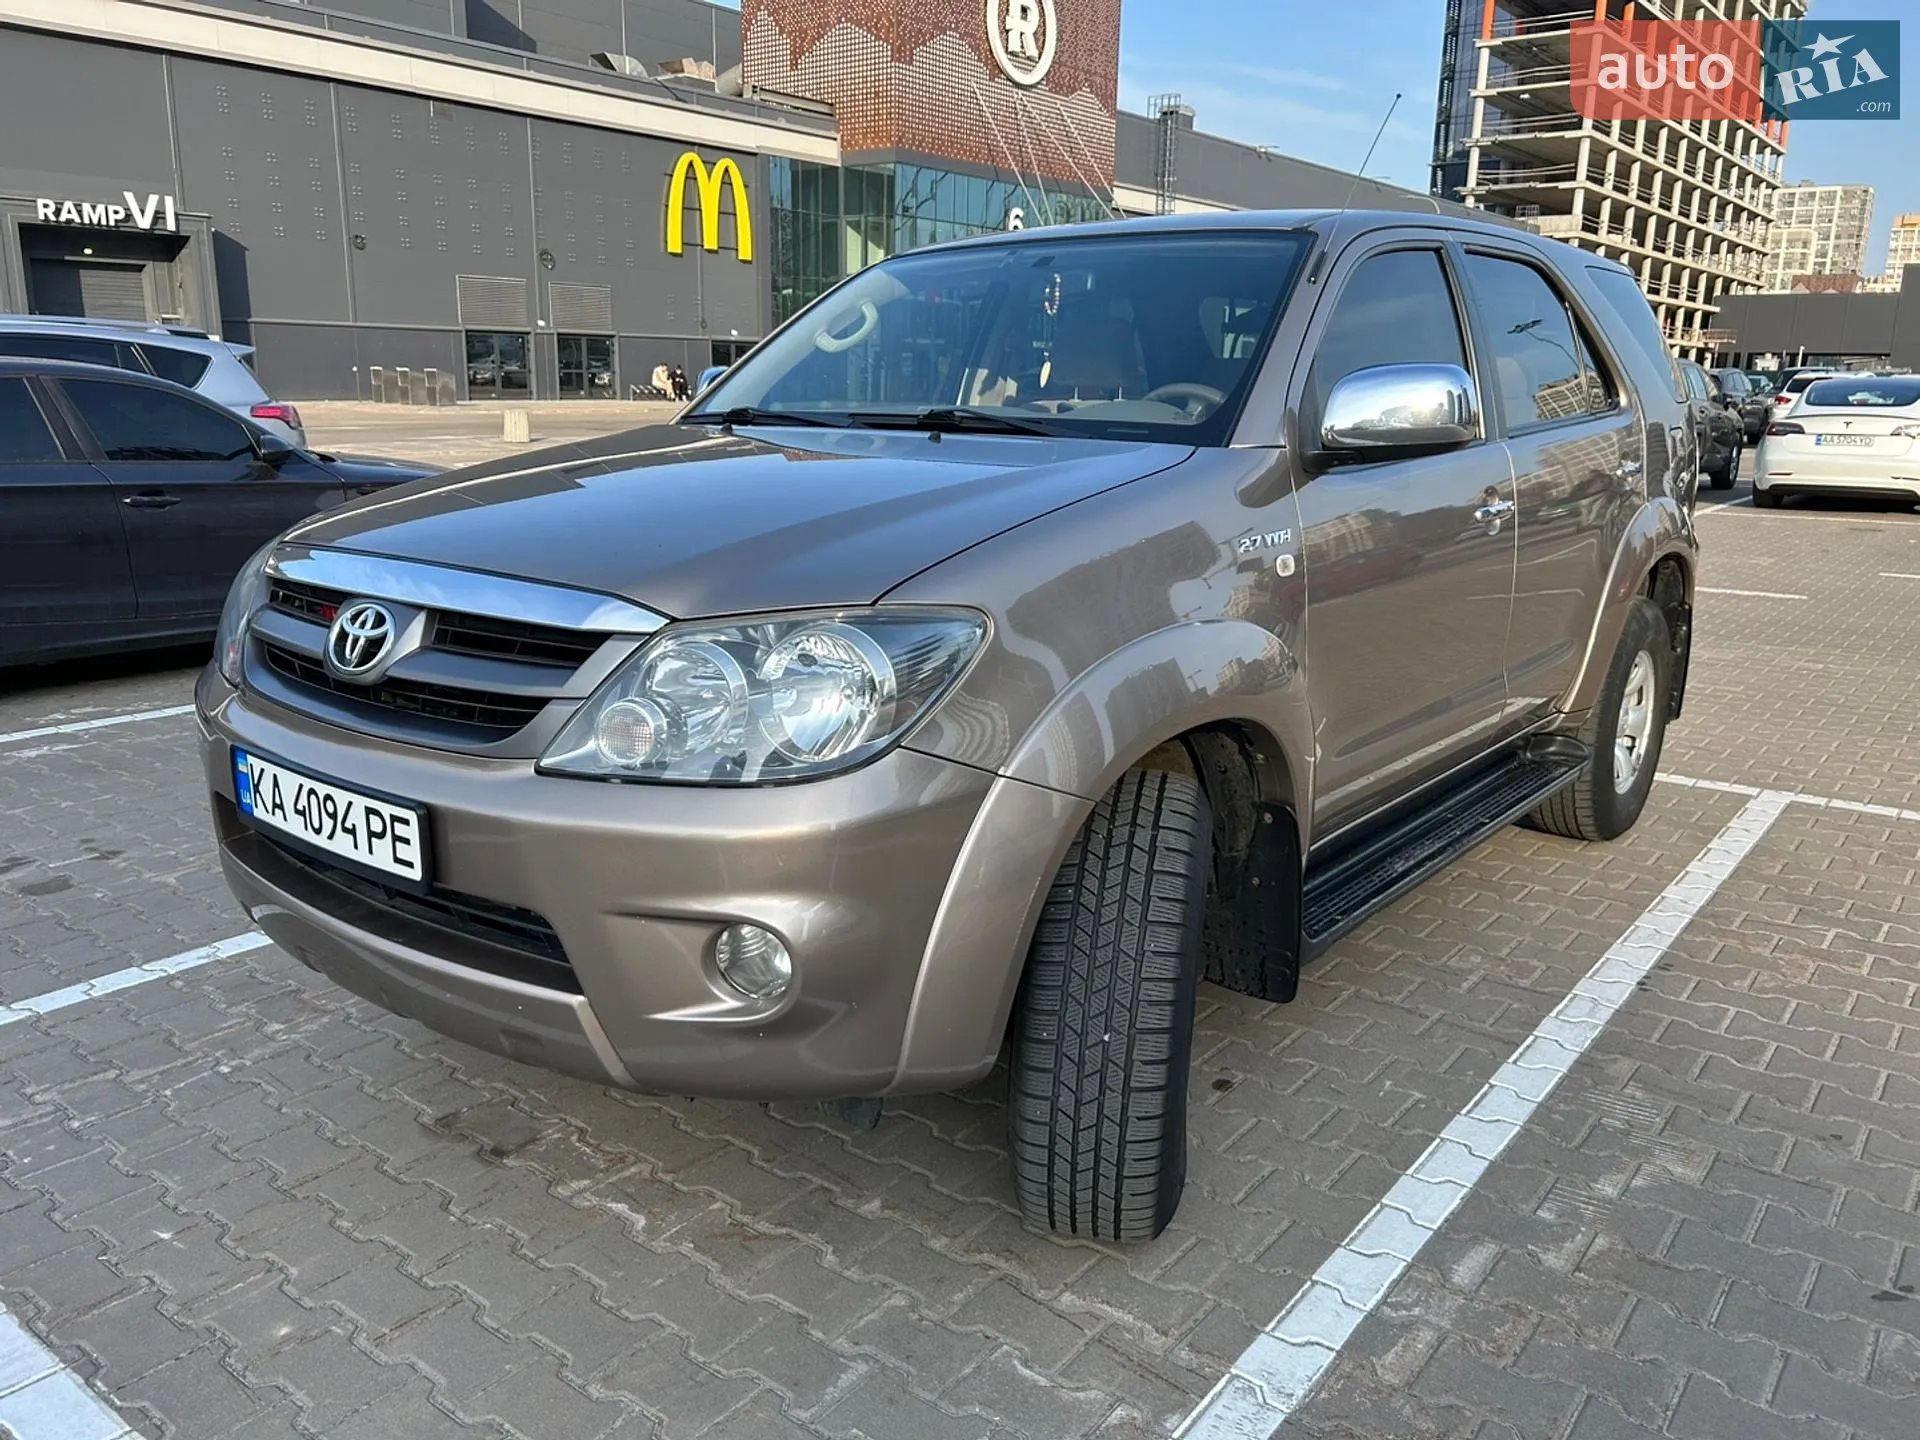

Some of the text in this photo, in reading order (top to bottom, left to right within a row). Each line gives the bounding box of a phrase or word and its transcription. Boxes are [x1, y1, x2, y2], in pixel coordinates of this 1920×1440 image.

[36, 191, 176, 231] RAMP VI
[1009, 207, 1024, 231] 6
[250, 763, 415, 869] KA 4094 PE
